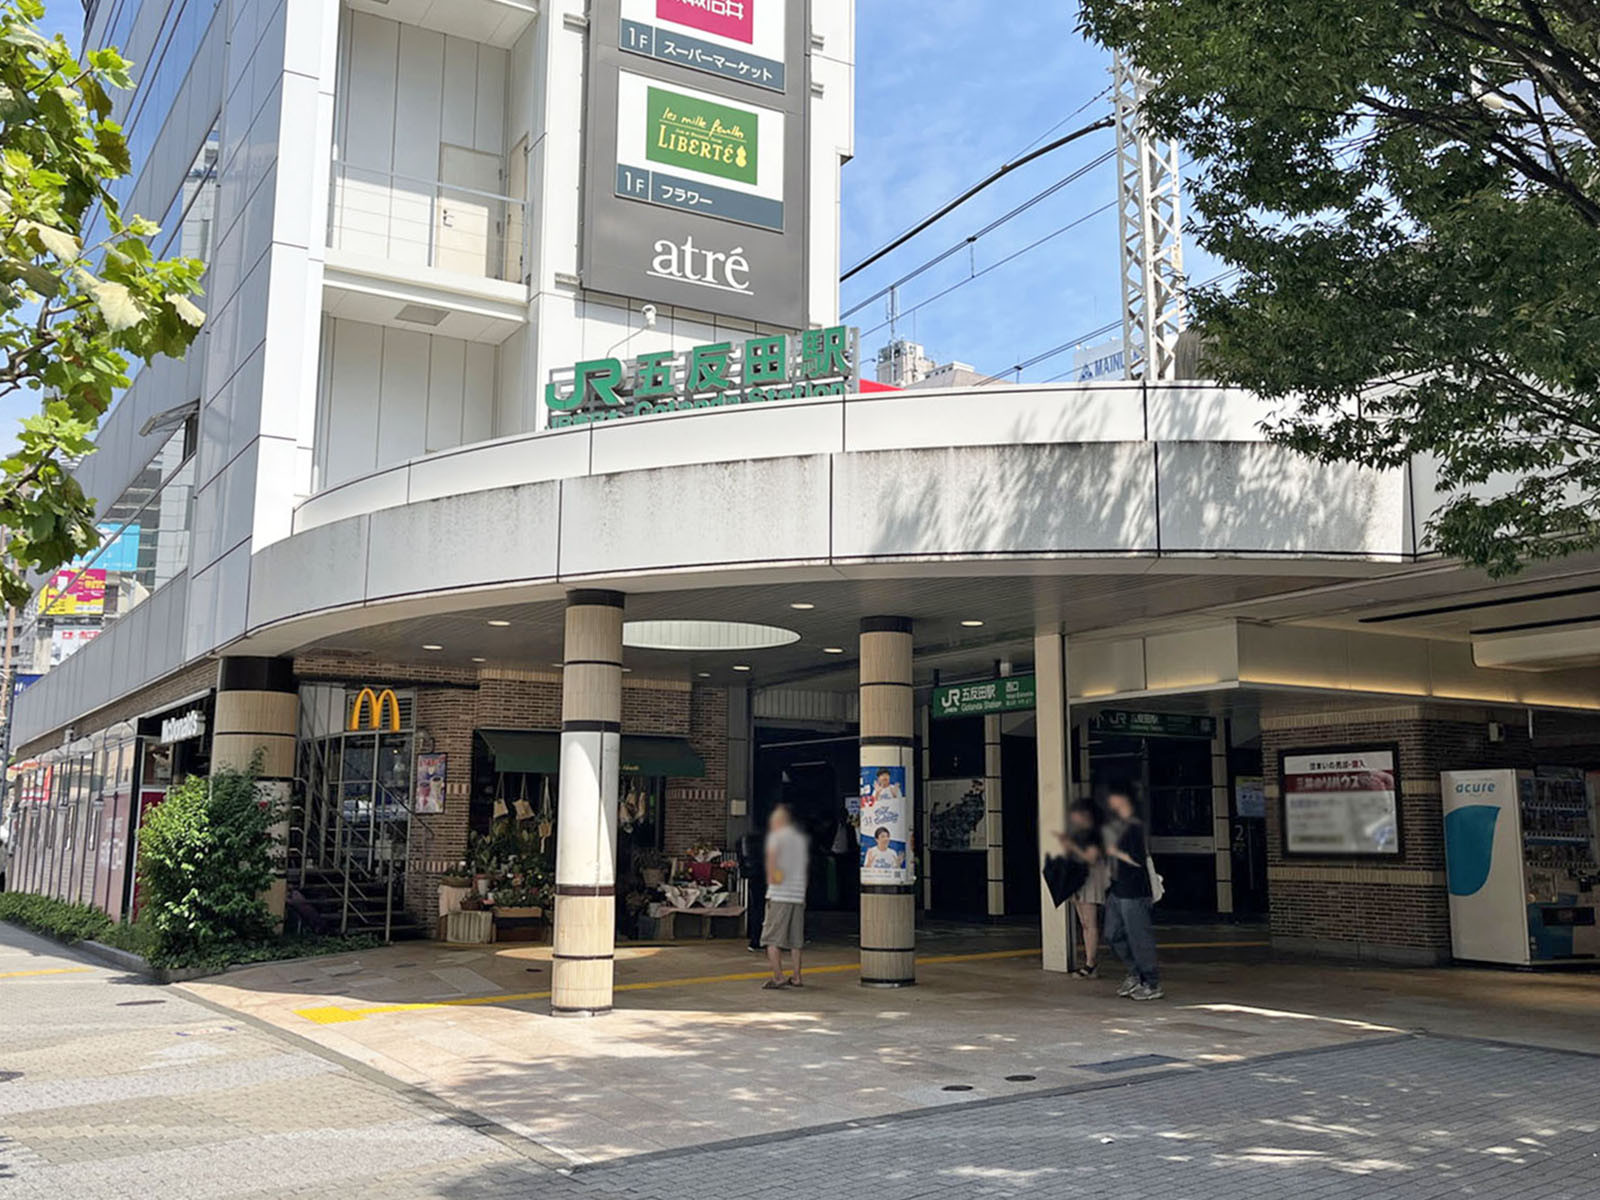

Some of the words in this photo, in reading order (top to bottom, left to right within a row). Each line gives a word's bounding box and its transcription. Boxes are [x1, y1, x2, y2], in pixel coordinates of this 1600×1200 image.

[628, 27, 649, 48] 1F
[663, 41, 773, 82] スーパーマーケット
[662, 107, 677, 121] les
[624, 171, 645, 193] 1F
[660, 185, 713, 205] フラワー
[651, 235, 751, 290] atré
[1455, 783, 1496, 793] acure
